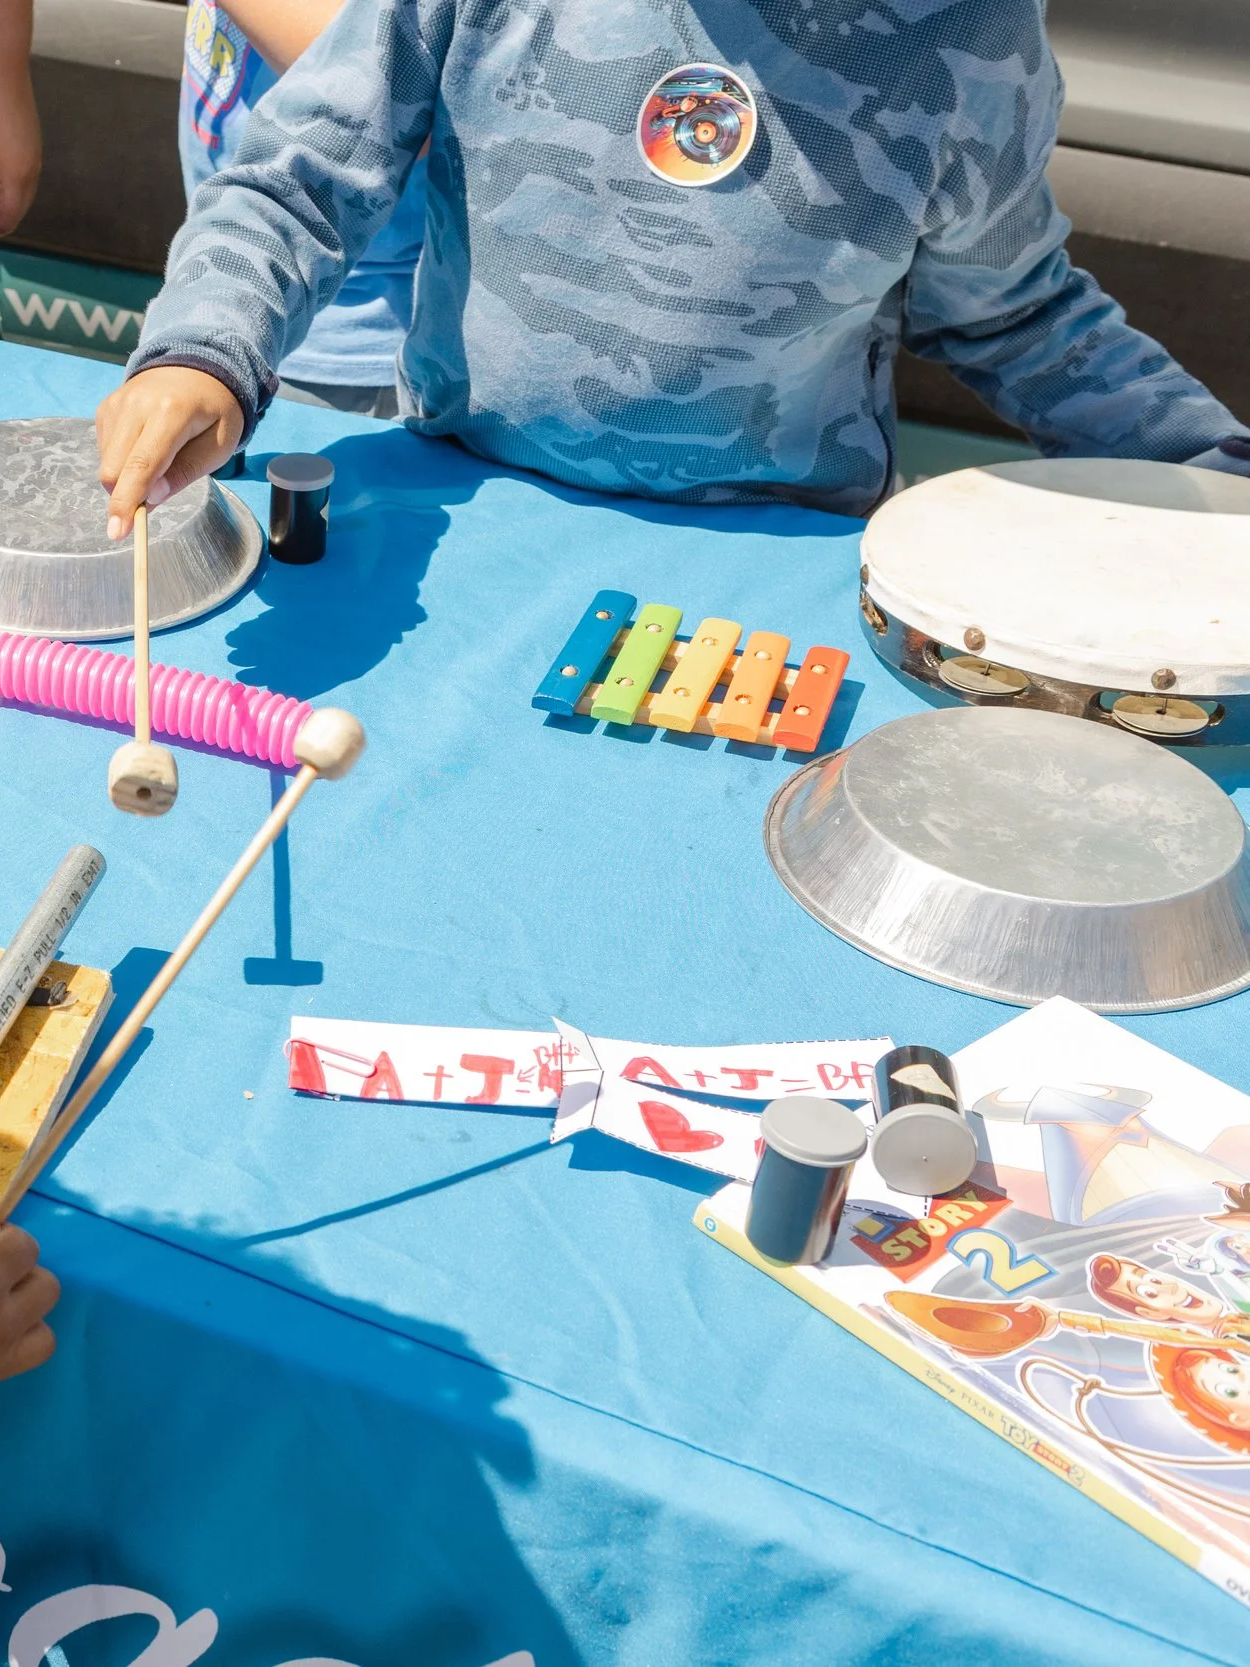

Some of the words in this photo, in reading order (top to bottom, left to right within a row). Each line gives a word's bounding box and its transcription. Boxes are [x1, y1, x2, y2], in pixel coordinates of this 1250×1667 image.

[15, 964, 35, 995] E-Z
[33, 934, 56, 966] PULL
[55, 906, 73, 930] 1/2
[70, 889, 83, 907] IN
[81, 859, 101, 889] EMT
[880, 1189, 990, 1262] STORY
[945, 1226, 1059, 1297] 2
[959, 1391, 996, 1420] PIXAR
[1000, 1414, 1041, 1451] TOY
